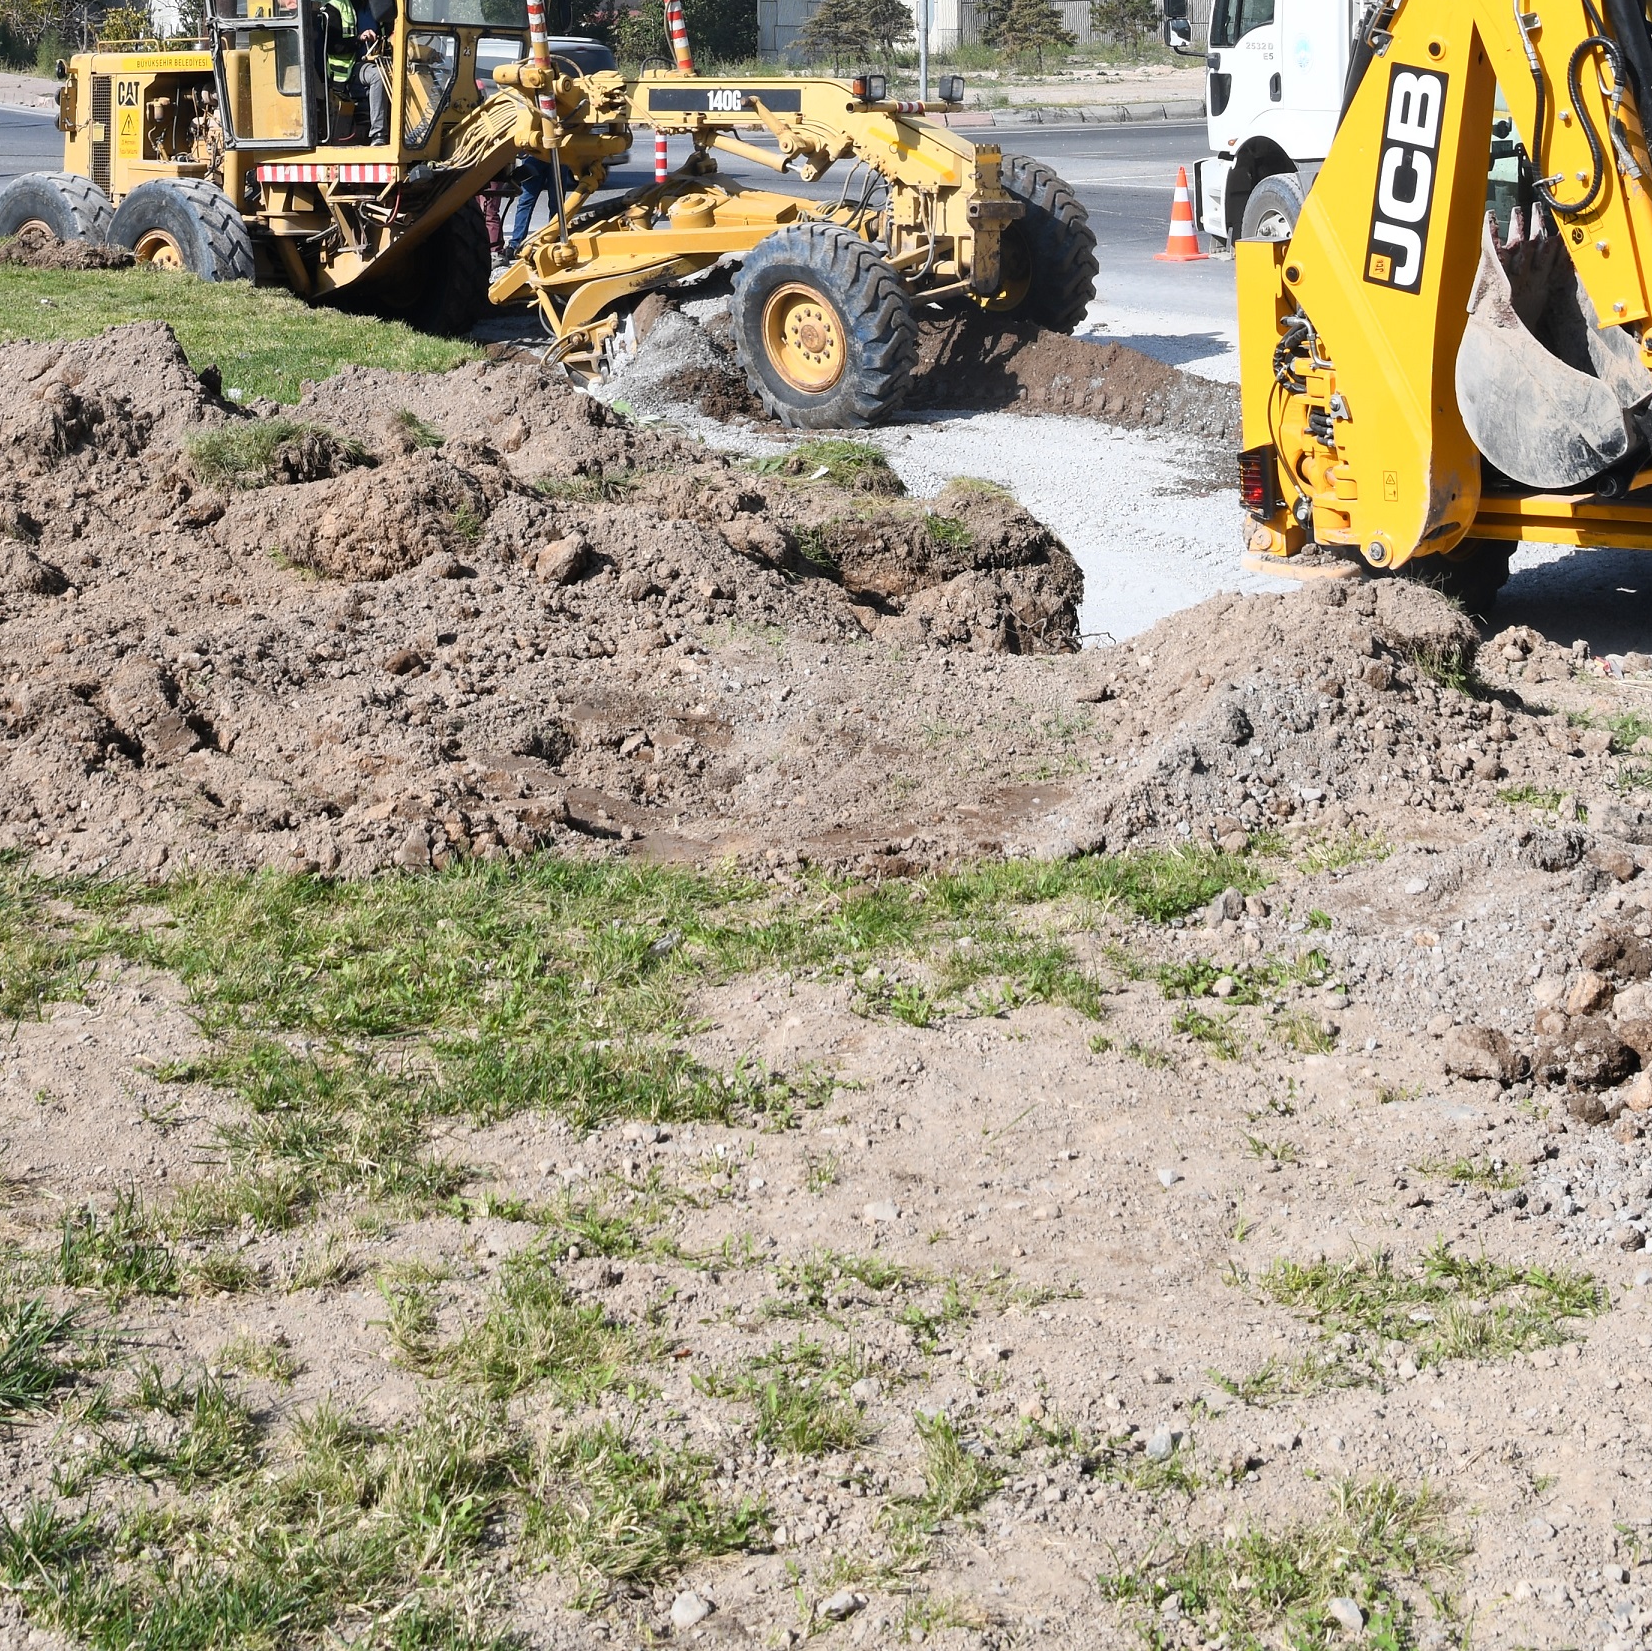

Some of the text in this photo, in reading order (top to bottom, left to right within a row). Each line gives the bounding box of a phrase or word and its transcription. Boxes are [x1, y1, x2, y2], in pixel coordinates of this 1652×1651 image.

[136, 58, 208, 68] BÜYÜKŞEHİR BELEDİYESİ
[118, 81, 140, 106] CAT
[707, 90, 742, 111] 140G
[1373, 72, 1442, 286] JCB
